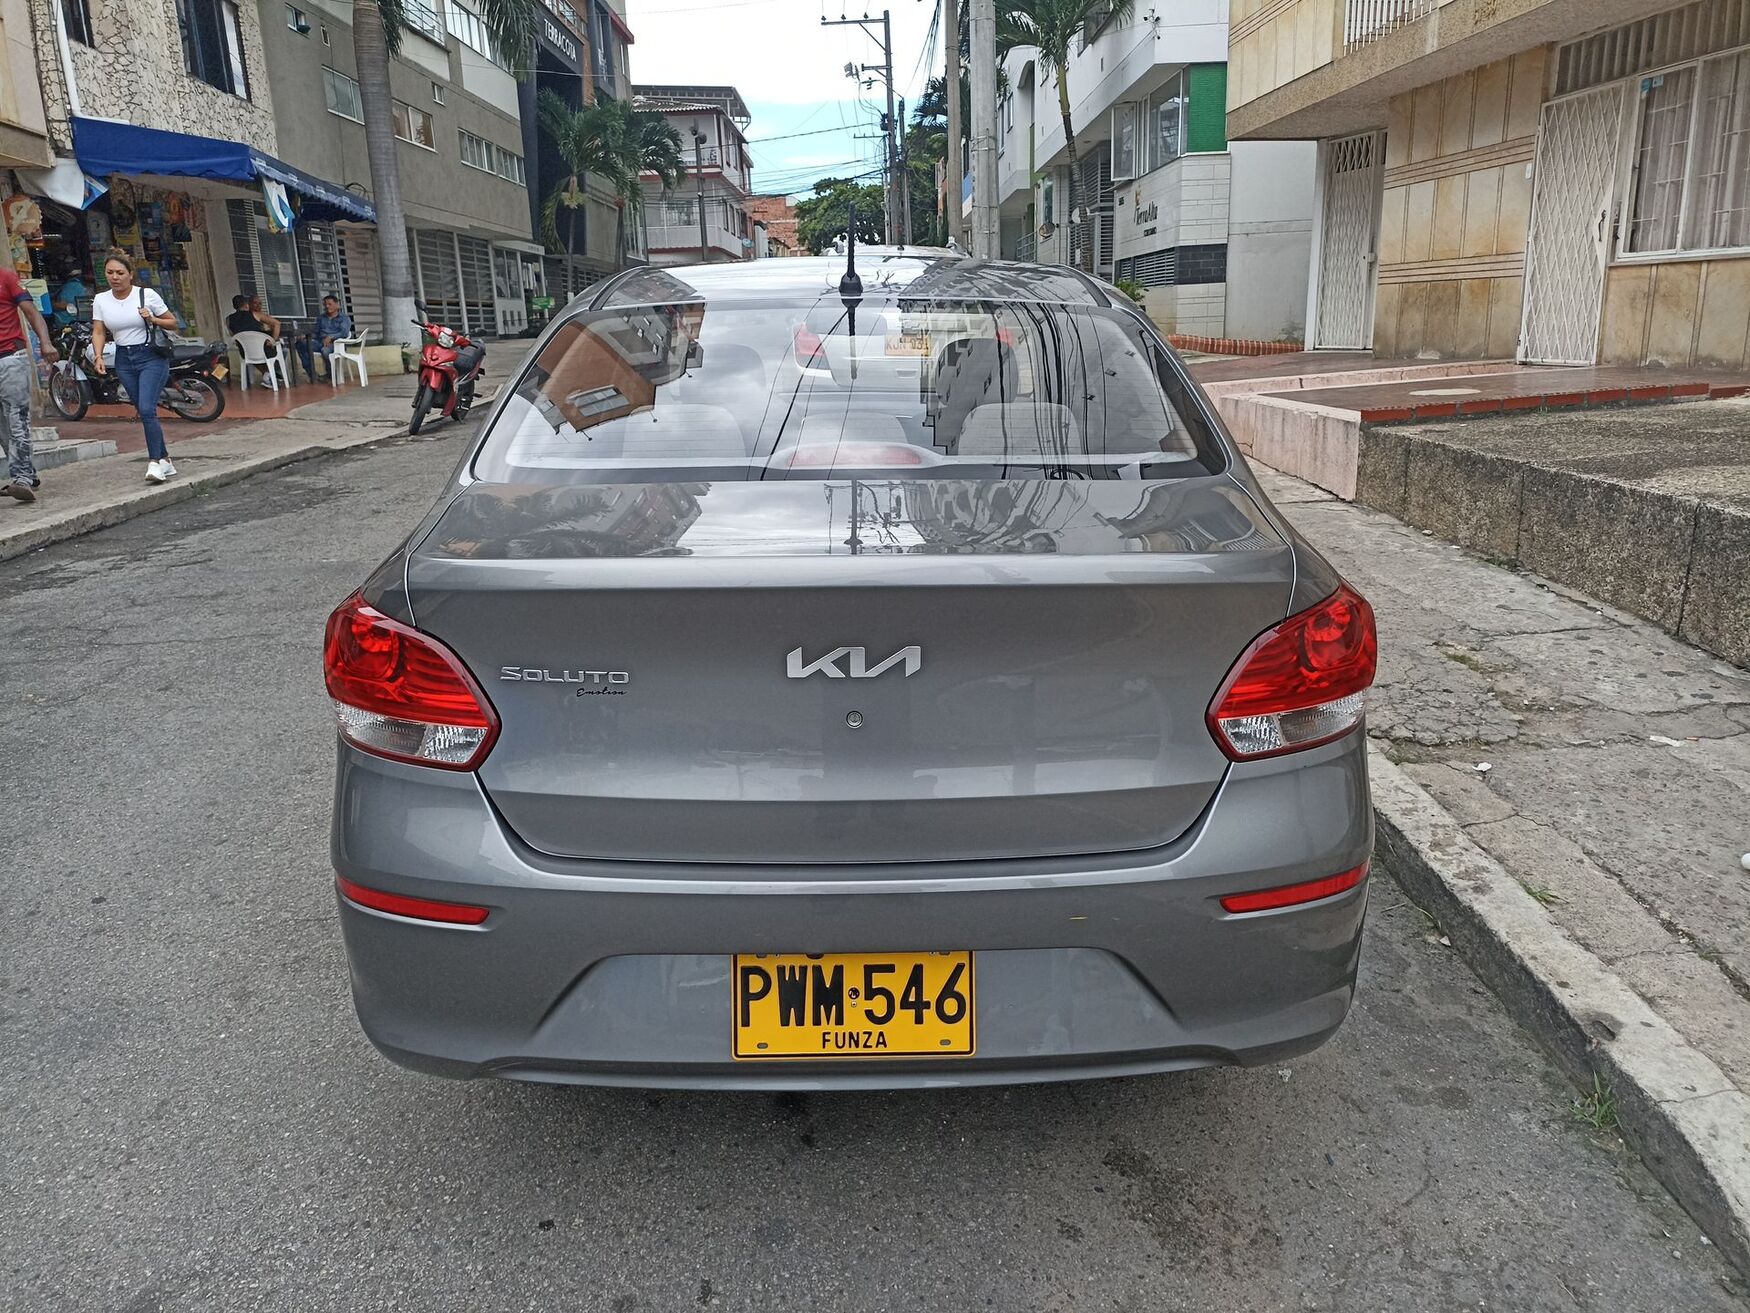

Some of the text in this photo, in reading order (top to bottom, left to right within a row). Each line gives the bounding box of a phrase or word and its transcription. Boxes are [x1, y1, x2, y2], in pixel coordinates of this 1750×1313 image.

[544, 18, 577, 62] TERRACOTA
[787, 645, 921, 678] KIA
[500, 666, 629, 684] SOLUTO
[576, 686, 627, 697] Emotion
[740, 962, 967, 1028] PWM 546
[822, 1031, 888, 1049] FUNZA
